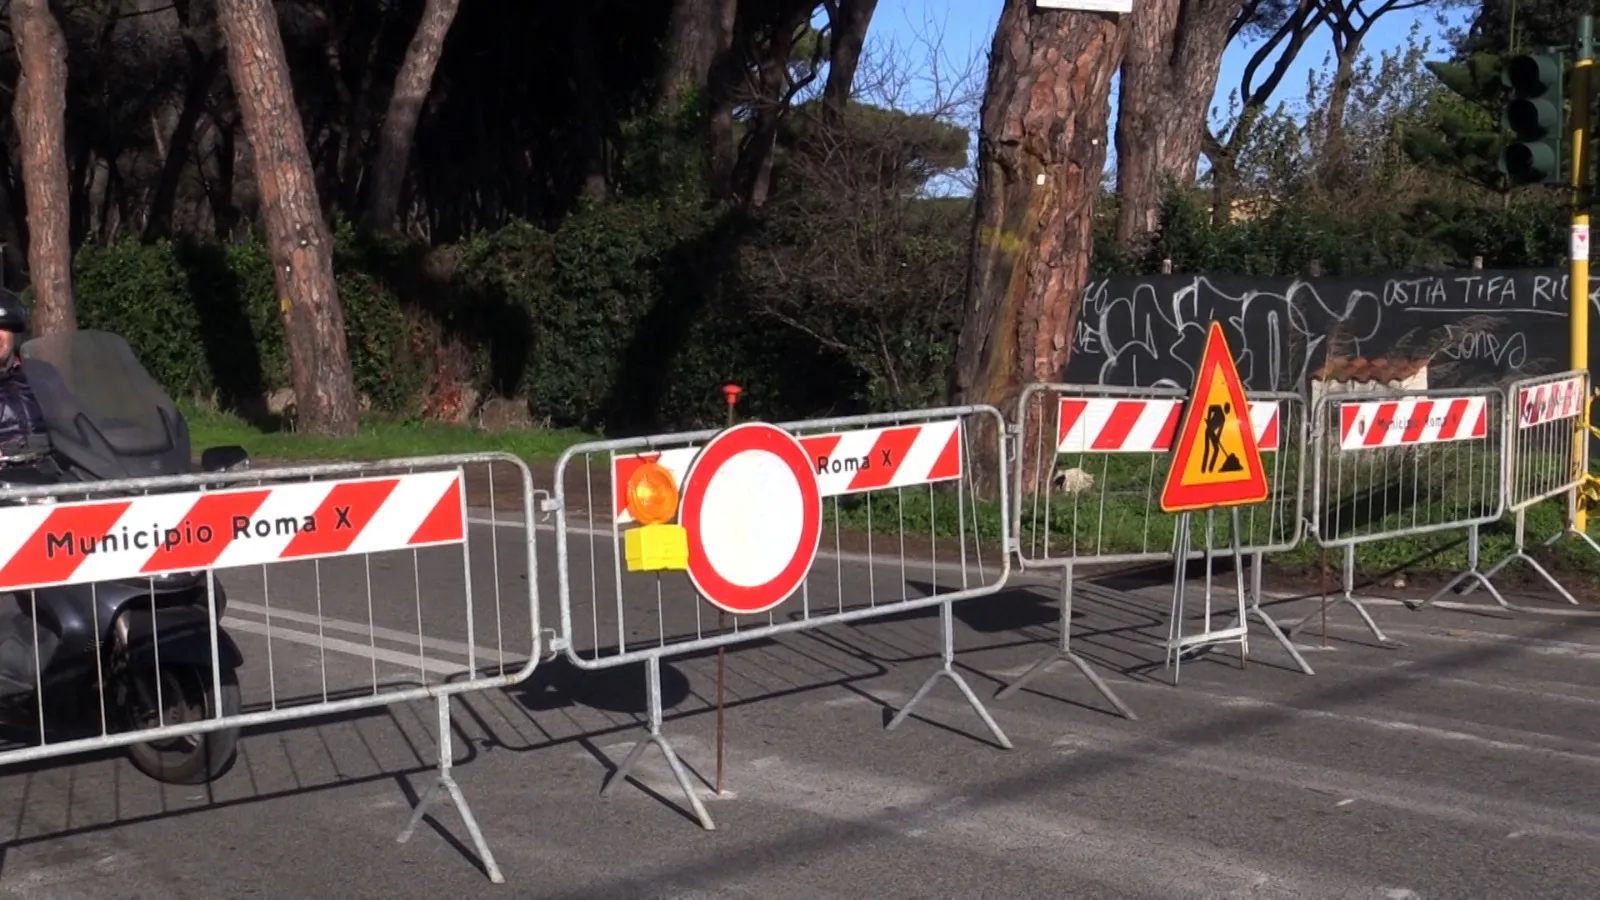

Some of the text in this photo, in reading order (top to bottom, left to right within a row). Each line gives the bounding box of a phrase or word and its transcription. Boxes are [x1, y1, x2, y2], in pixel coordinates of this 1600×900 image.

[817, 449, 892, 475] Roma X
[46, 505, 352, 558] Municipio Roma X
